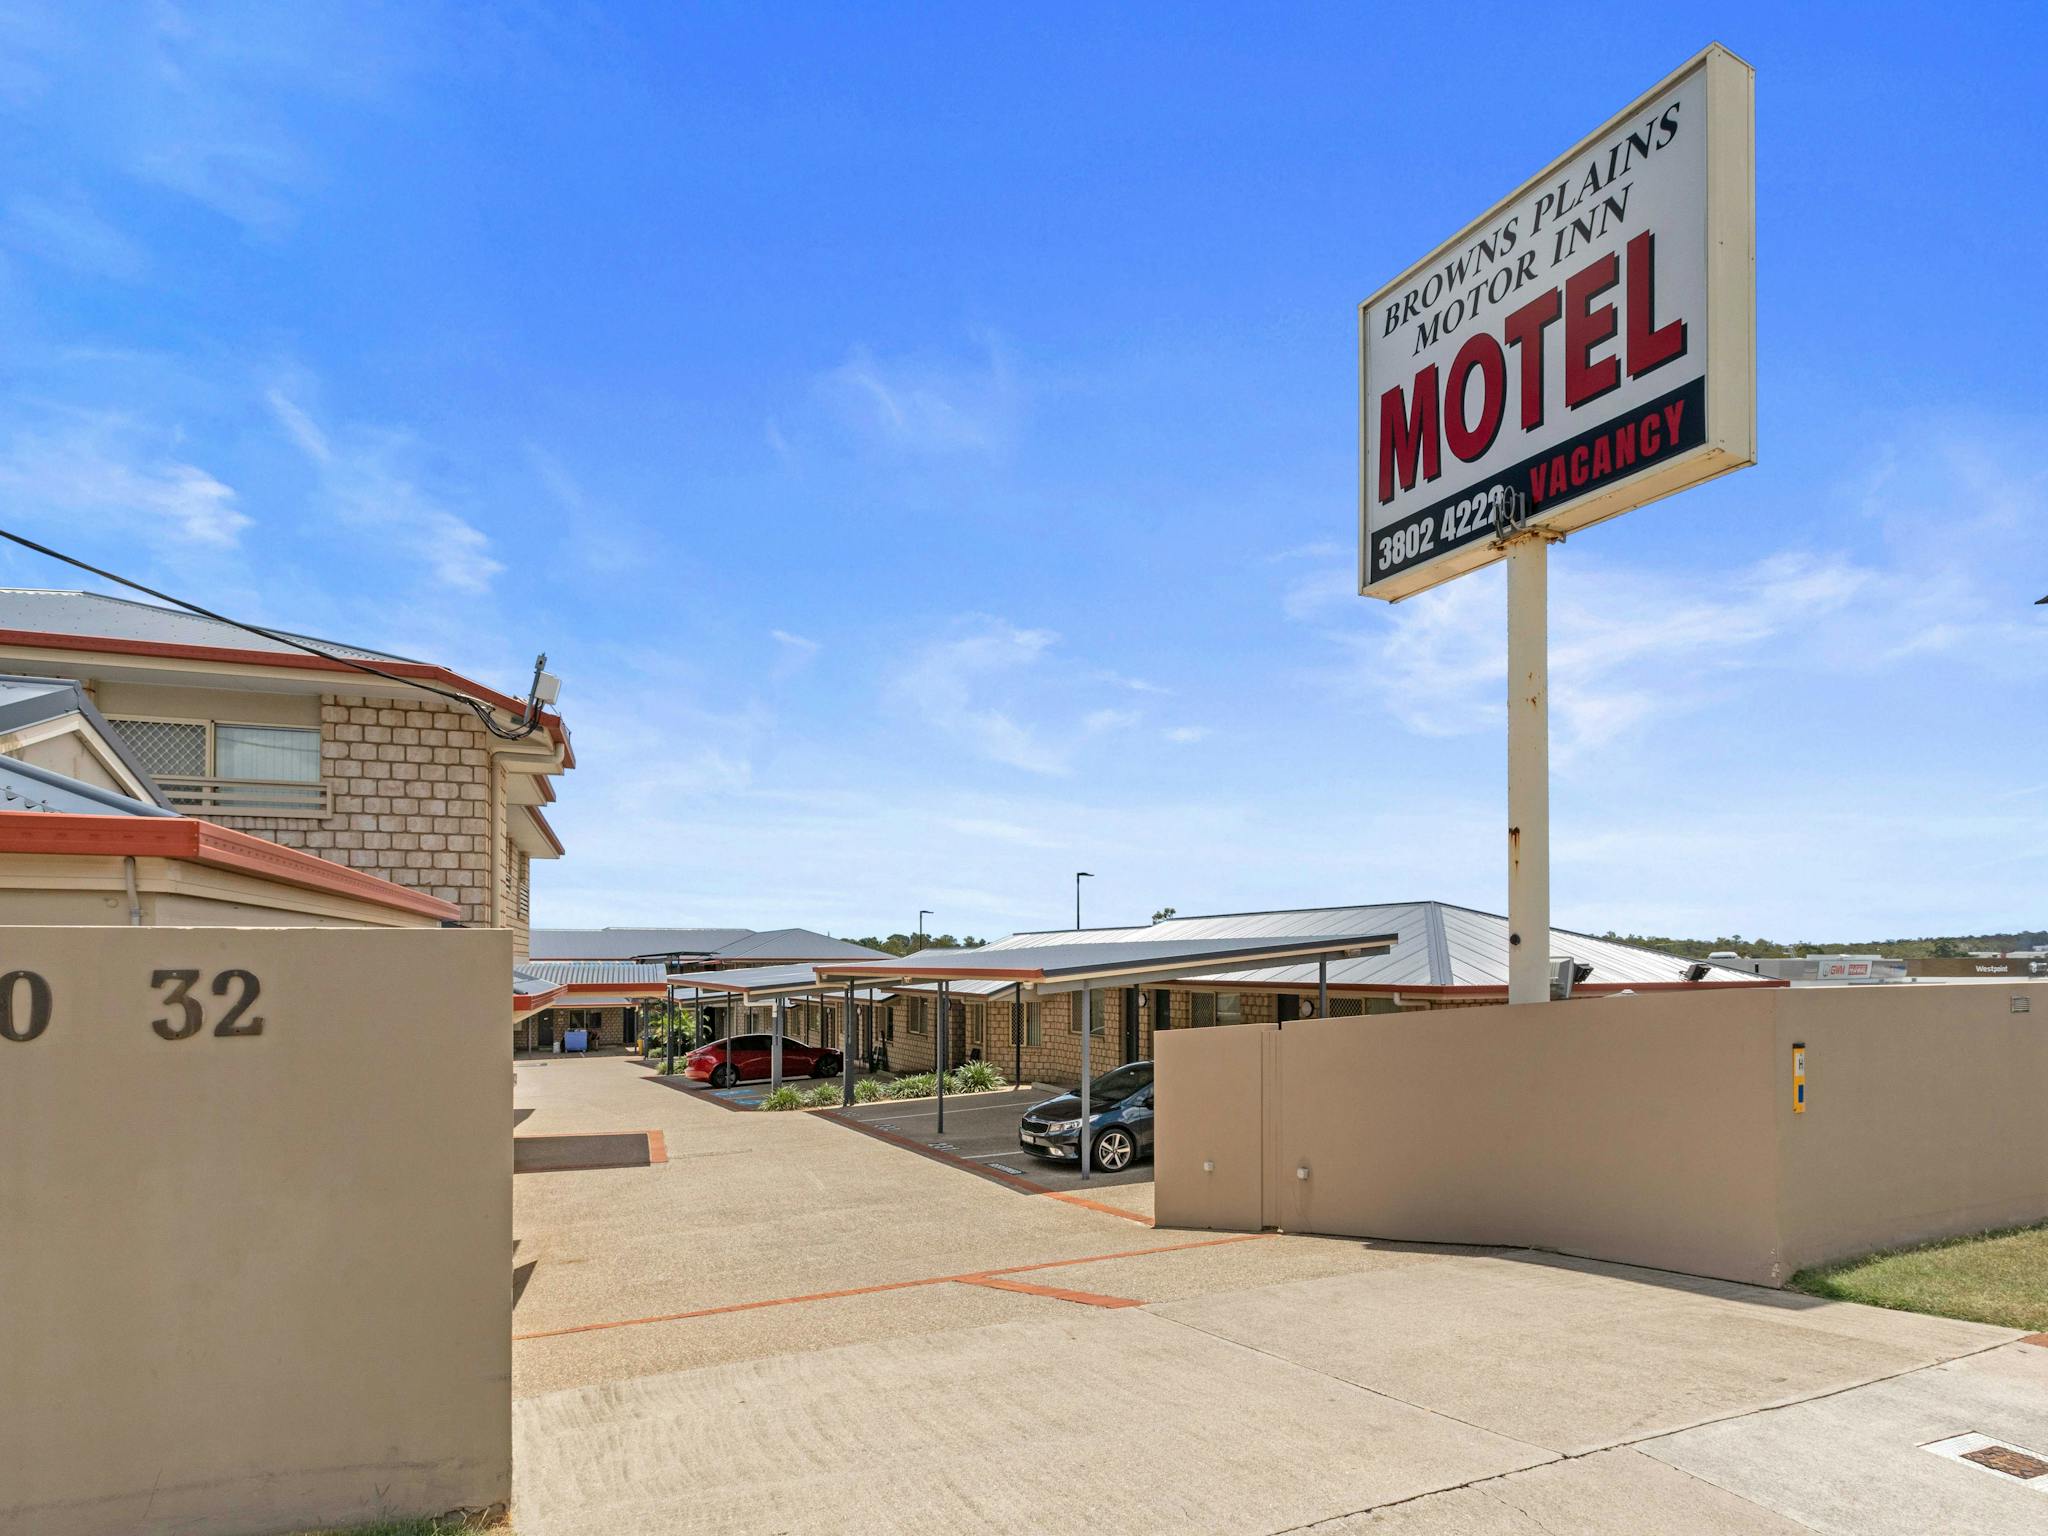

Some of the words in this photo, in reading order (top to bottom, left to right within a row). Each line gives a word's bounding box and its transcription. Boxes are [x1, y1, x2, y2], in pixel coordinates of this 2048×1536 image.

[1383, 216, 1519, 339] BROWNS
[1530, 101, 1680, 237] PLAINS
[1412, 249, 1538, 357] MOTOR
[1550, 182, 1634, 268] INN
[1378, 228, 1687, 504] MOTEL
[1529, 400, 1687, 505] VACANCY
[1378, 516, 1435, 571] 3802
[151, 969, 264, 1041] 32
[1975, 964, 2009, 973] Westpoint
